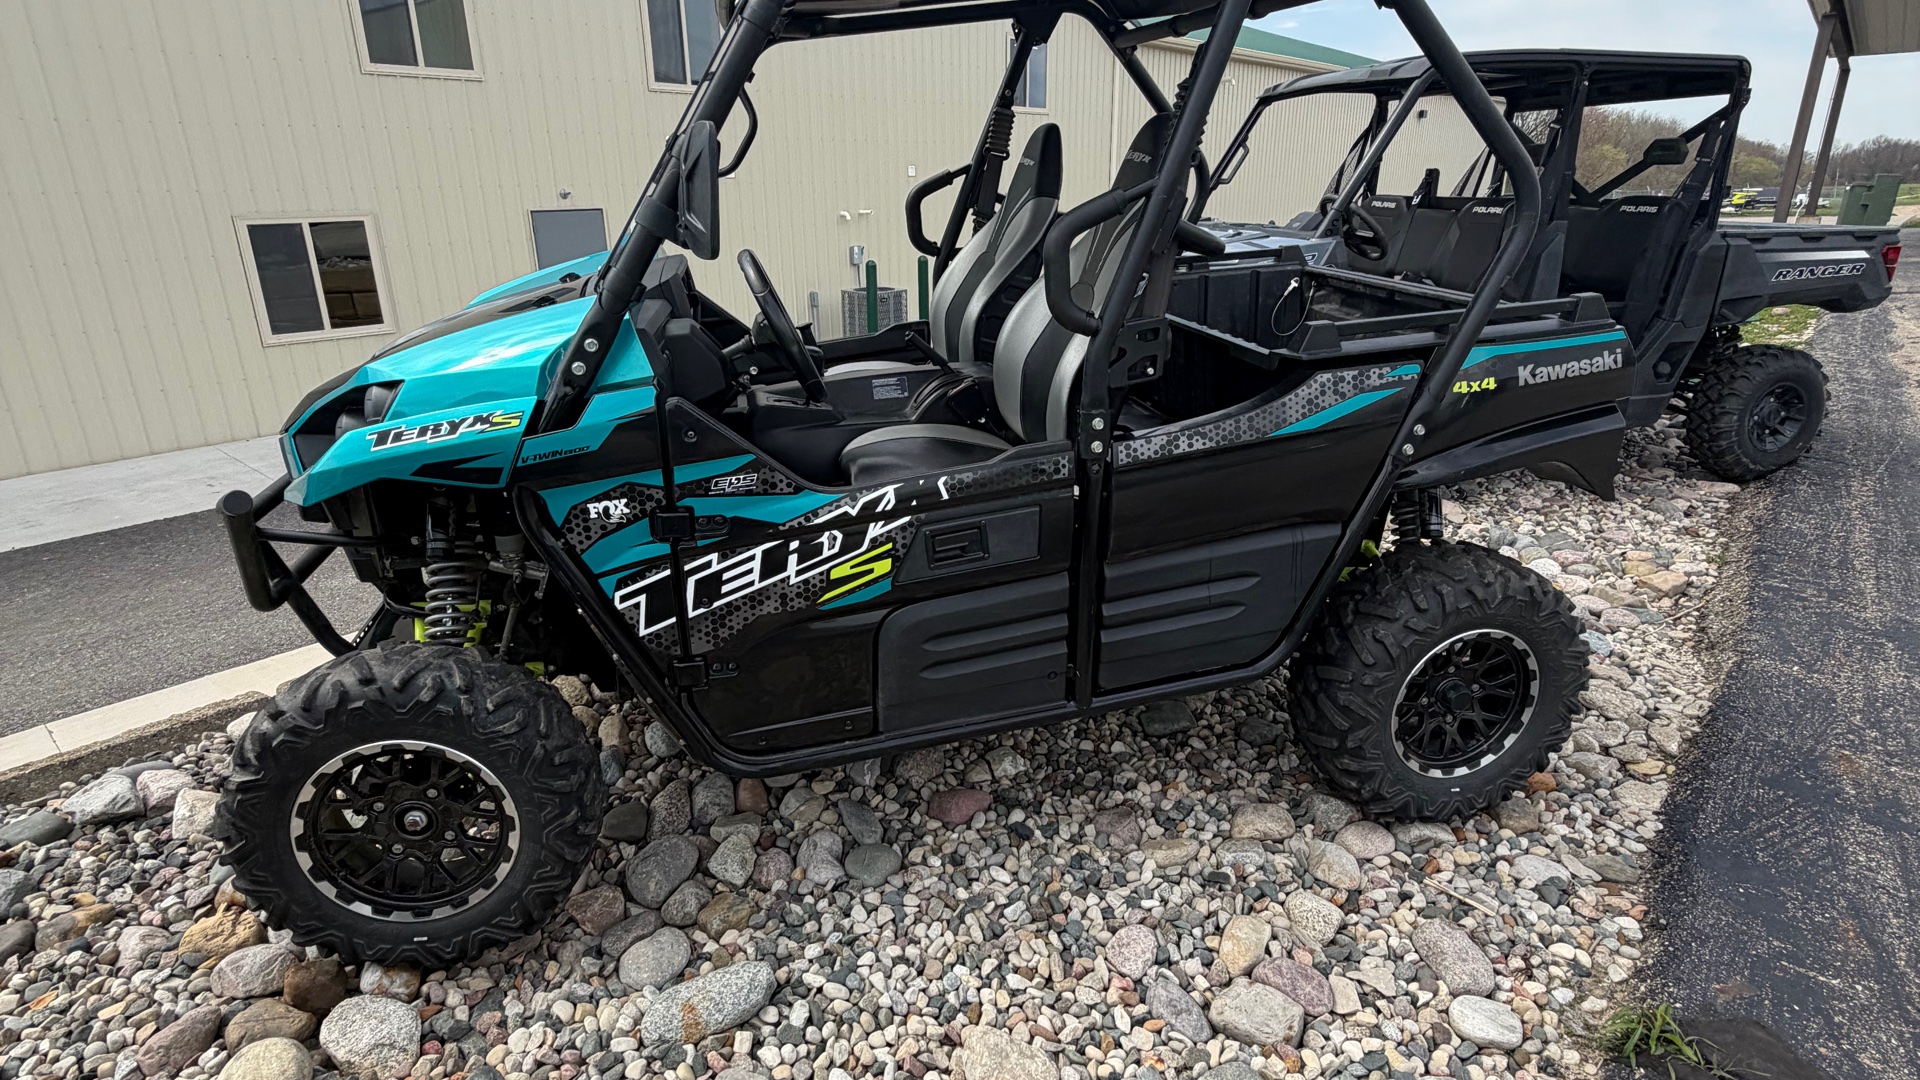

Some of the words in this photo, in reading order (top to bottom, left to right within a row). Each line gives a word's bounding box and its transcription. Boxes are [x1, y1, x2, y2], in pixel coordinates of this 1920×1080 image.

[1370, 200, 1397, 210] POLARIS
[1619, 205, 1659, 214] POLARIS
[1771, 263, 1867, 282] RANGER
[1517, 348, 1624, 388] Kawasaki
[1452, 376, 1498, 394] 4x4
[711, 473, 758, 494] EPS
[586, 498, 631, 523] FOX
